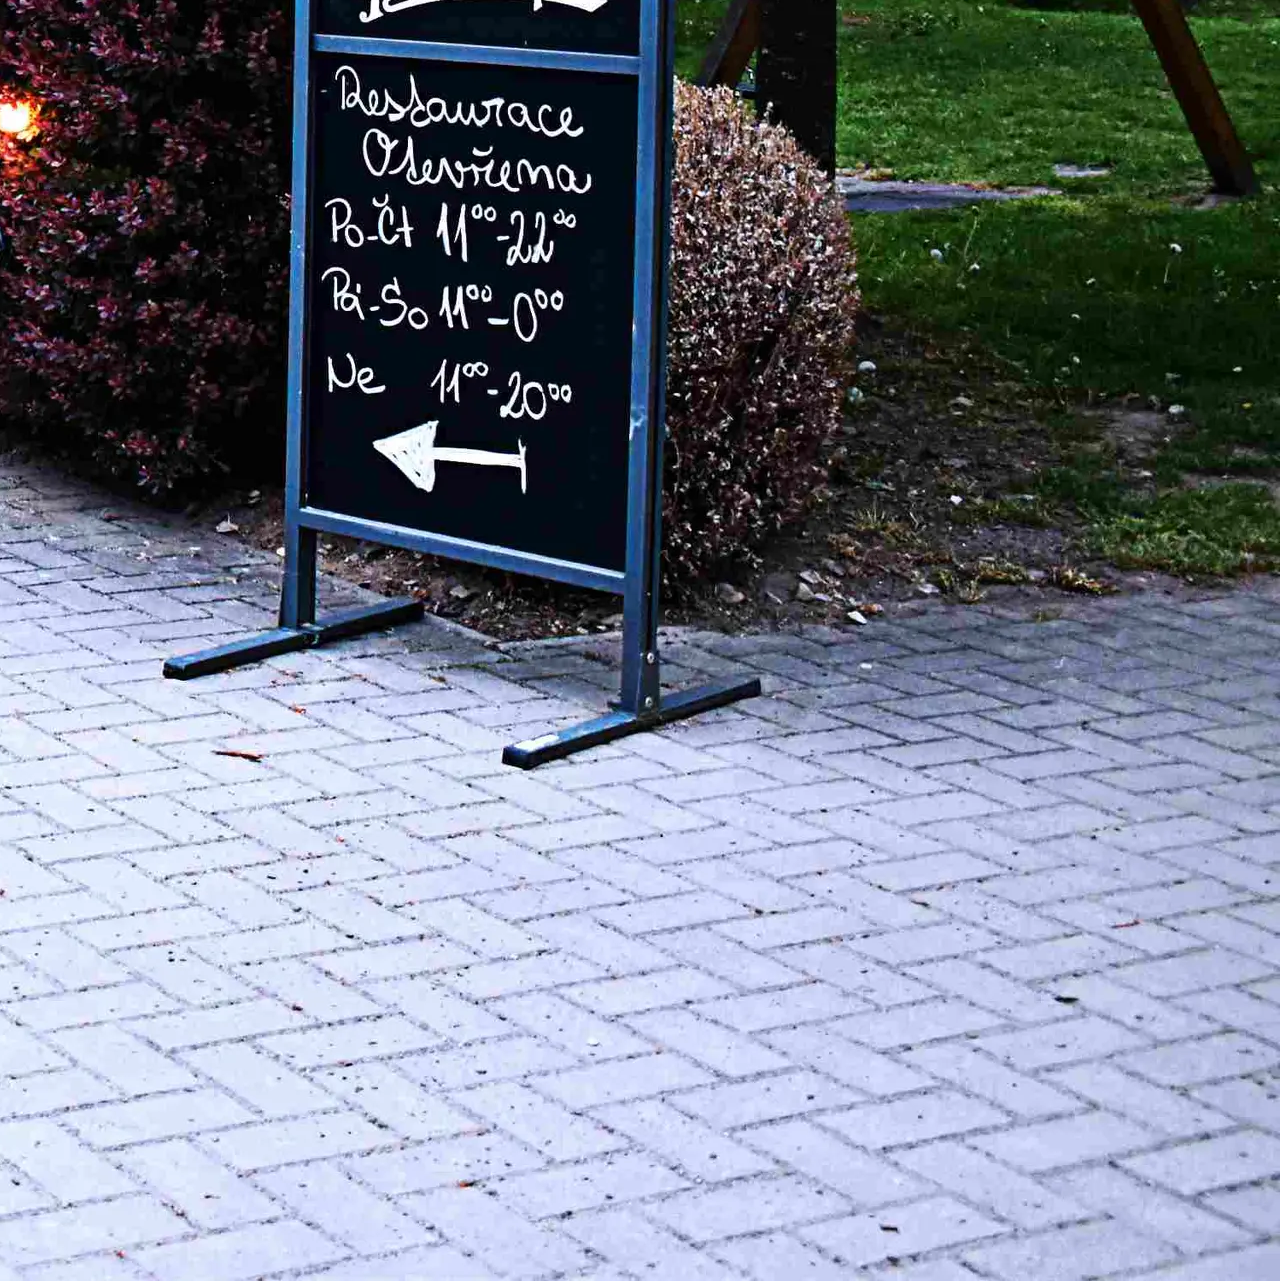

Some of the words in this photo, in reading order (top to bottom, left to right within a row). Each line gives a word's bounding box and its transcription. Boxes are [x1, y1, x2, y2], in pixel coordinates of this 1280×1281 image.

[335, 65, 584, 138] Restaurace
[362, 128, 592, 194] Otevřena
[327, 353, 386, 394] Ne
